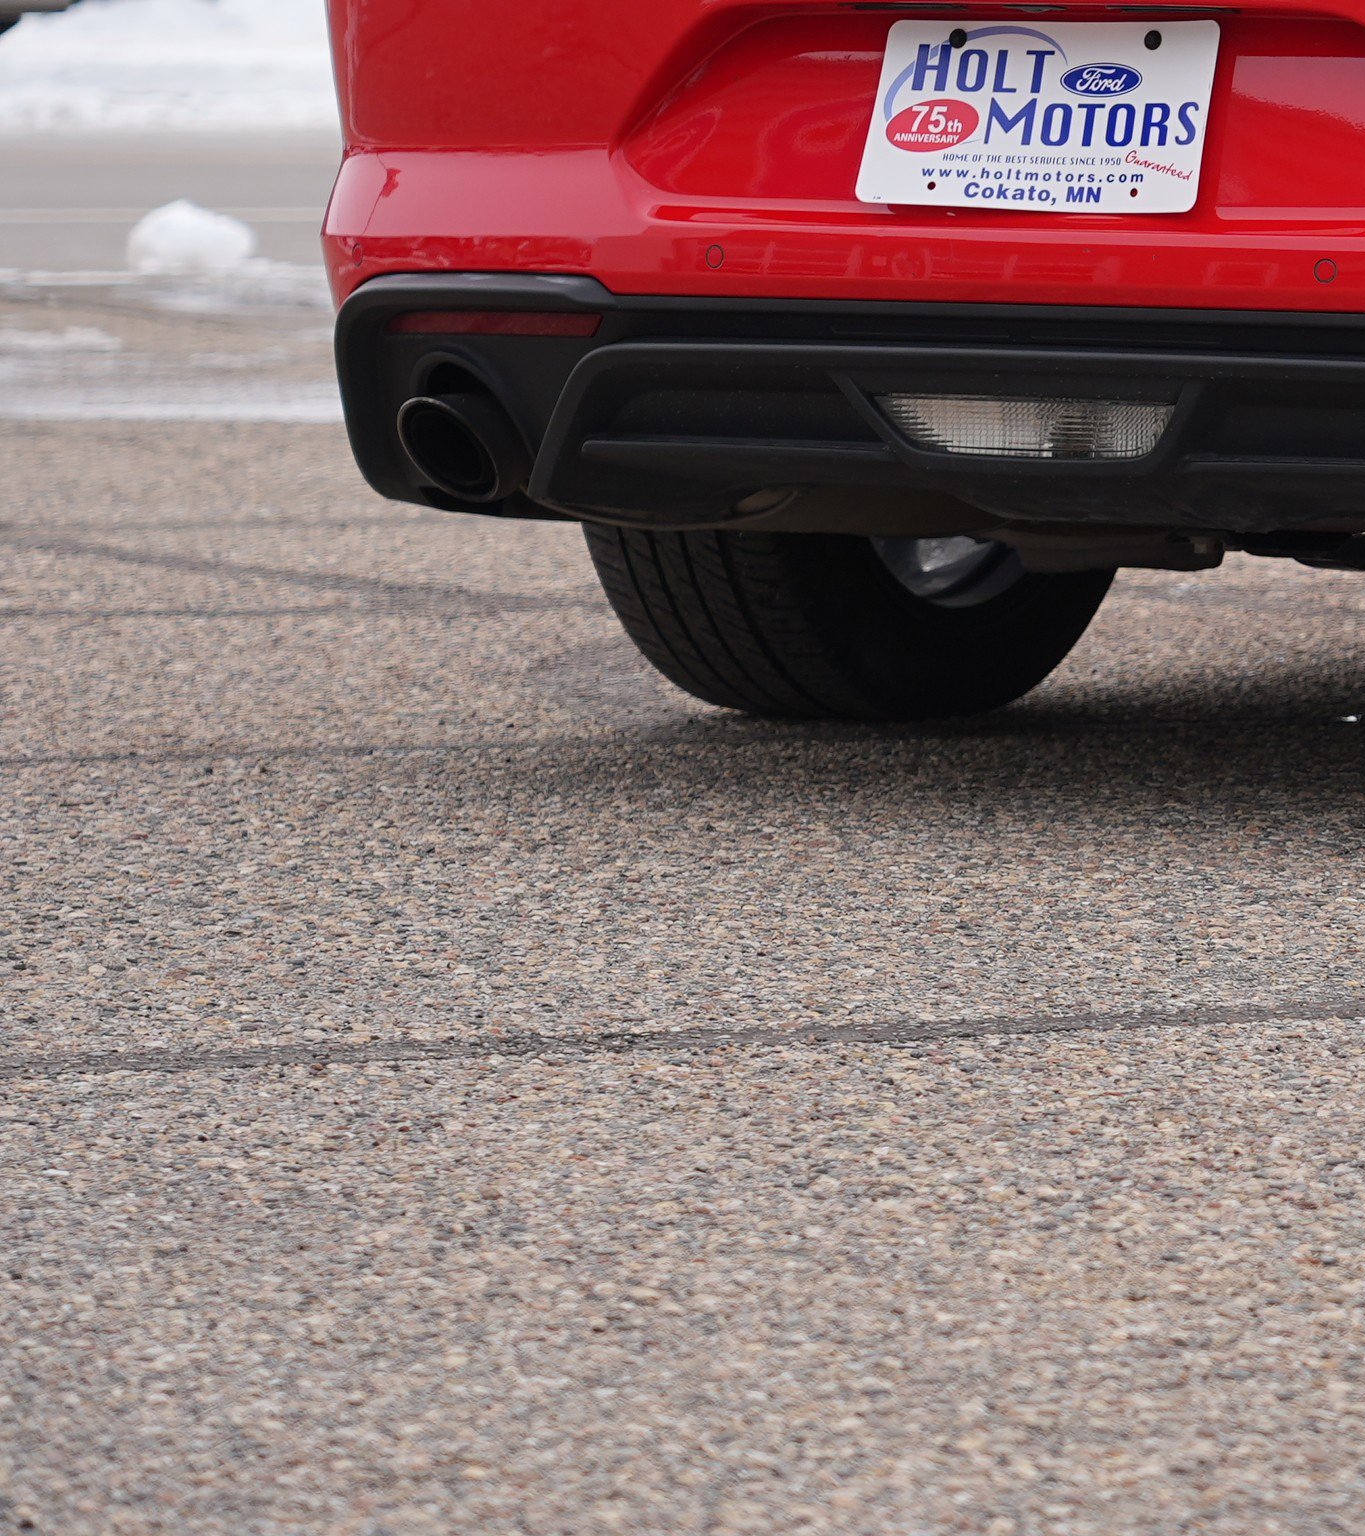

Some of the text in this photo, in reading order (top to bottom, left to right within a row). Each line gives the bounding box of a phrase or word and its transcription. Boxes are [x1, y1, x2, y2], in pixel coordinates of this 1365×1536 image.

[911, 43, 1056, 94] HOLT
[1075, 67, 1128, 92] Ford
[910, 104, 963, 134] 75th
[983, 96, 1200, 147] MOTORS
[893, 132, 960, 145] ANNIVERSARY
[942, 153, 1122, 167] HOME OF THE BEST SERVICE SINCE 1950
[1124, 149, 1193, 182] Guaranteed
[921, 167, 1145, 184] www.holtmotors.com
[963, 181, 1102, 206] Cokato, MN
